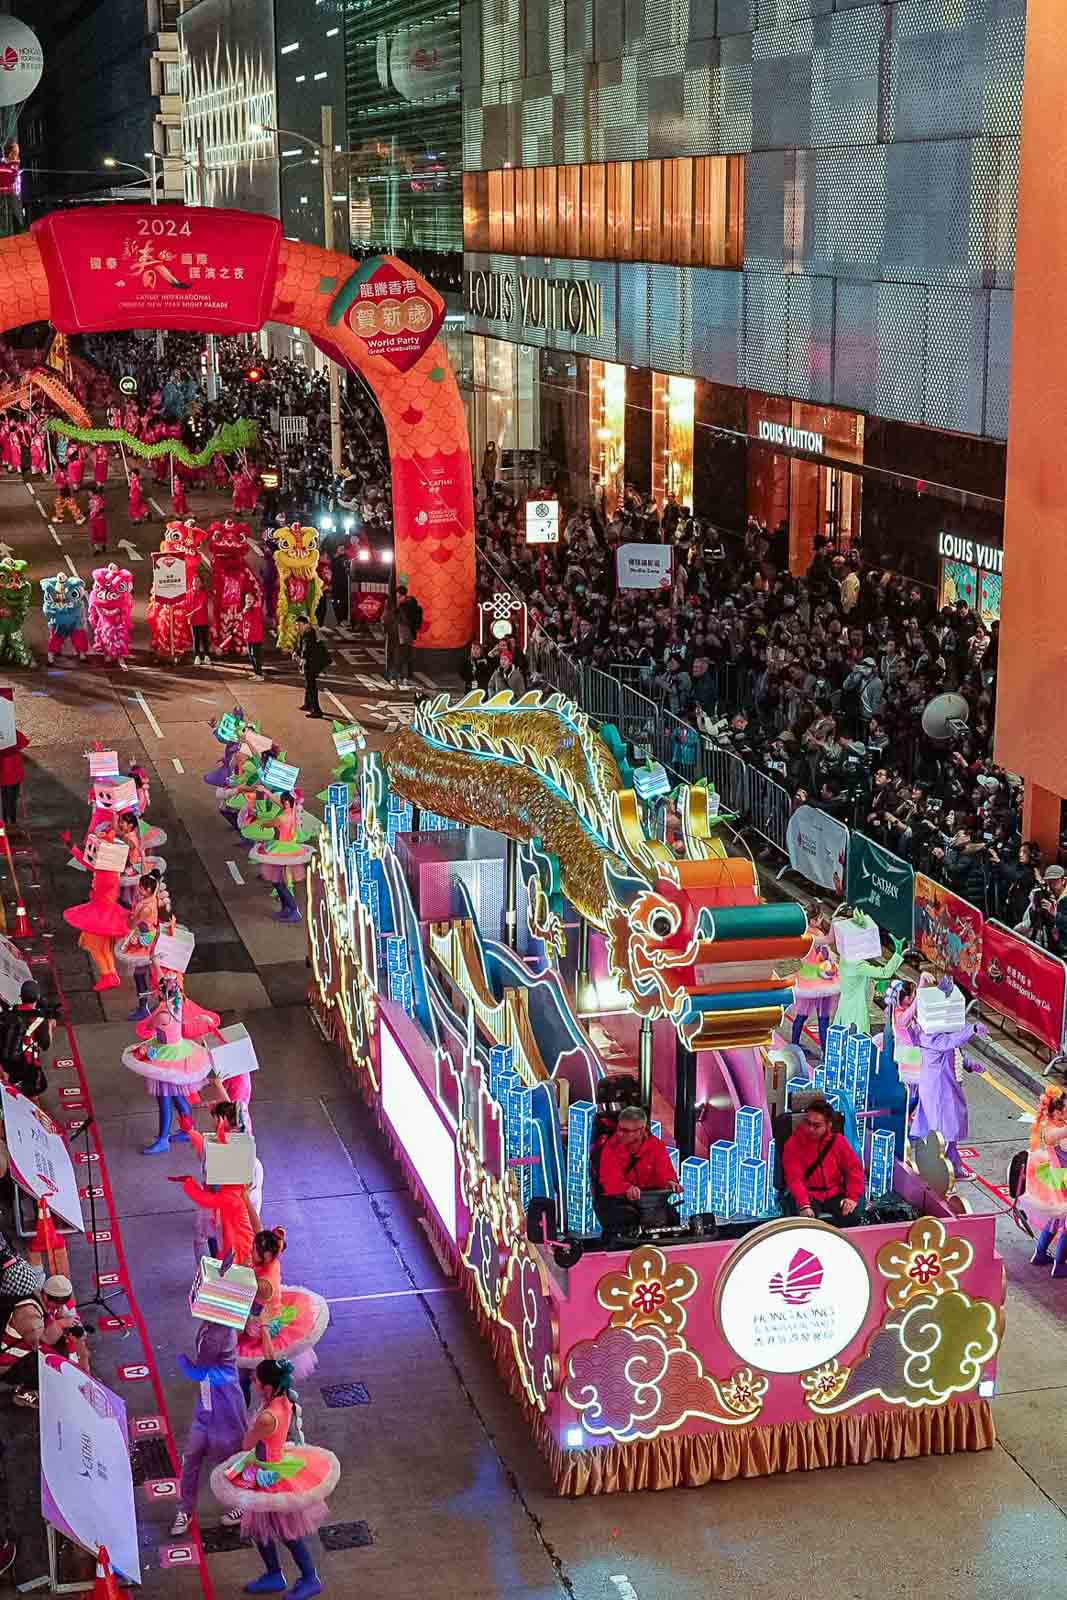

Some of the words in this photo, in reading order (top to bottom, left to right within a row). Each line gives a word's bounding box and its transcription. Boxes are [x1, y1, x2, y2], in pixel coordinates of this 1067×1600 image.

[136, 219, 192, 237] 2024
[469, 270, 514, 323] LOUIS
[518, 275, 601, 341] VUITTON
[368, 340, 396, 348] World
[397, 337, 420, 346] Party
[758, 420, 784, 444] LOUIS
[784, 426, 823, 453] VUITTON
[546, 520, 552, 529] 7
[546, 532, 557, 541] 12
[939, 532, 973, 563] LOUIS
[871, 872, 899, 900] CATHAY
[99, 1274, 119, 1285] A
[125, 1366, 147, 1378] A
[138, 1420, 158, 1431] B
[153, 1483, 175, 1496] C
[169, 1547, 191, 1562] D
